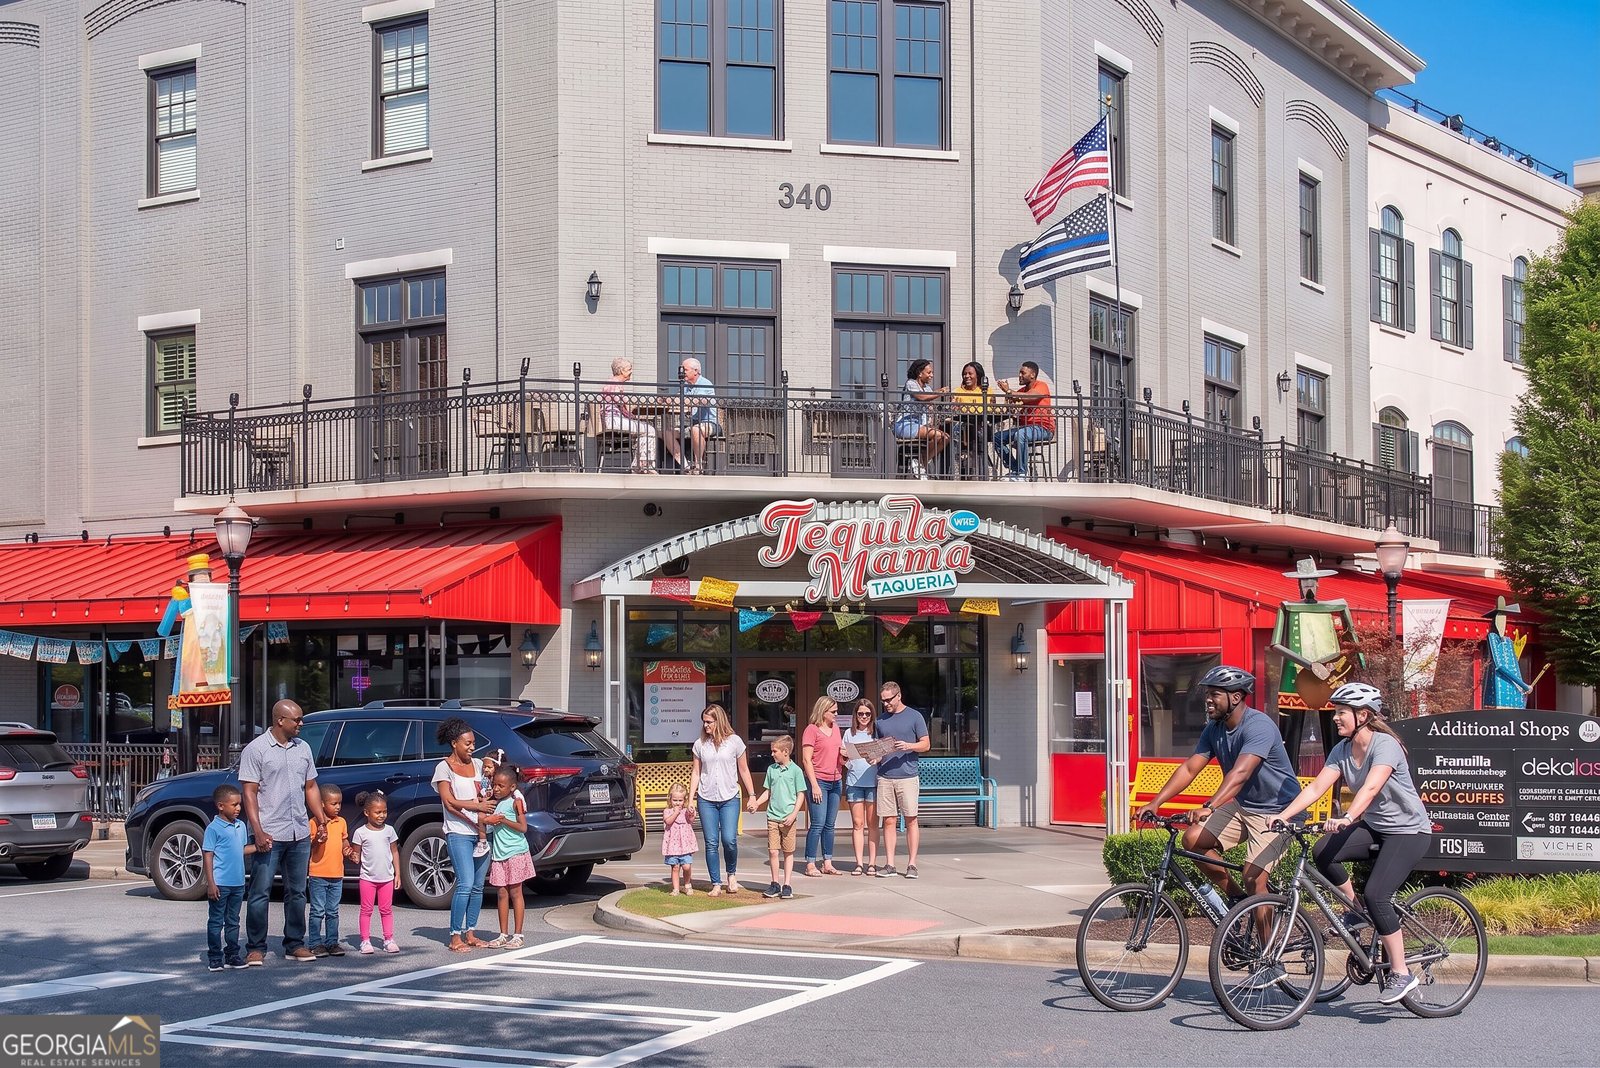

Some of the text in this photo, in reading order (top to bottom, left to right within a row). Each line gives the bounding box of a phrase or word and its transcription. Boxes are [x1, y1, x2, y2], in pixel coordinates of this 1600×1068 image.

[778, 182, 831, 211] 340
[758, 495, 950, 568] Tequila
[805, 541, 976, 603] Mama
[871, 573, 955, 596] TAQUERIA
[1427, 720, 1515, 736] Additional
[1519, 720, 1570, 741] Shops
[1476, 811, 1510, 821] Center
[1542, 841, 1594, 851] VICHER
